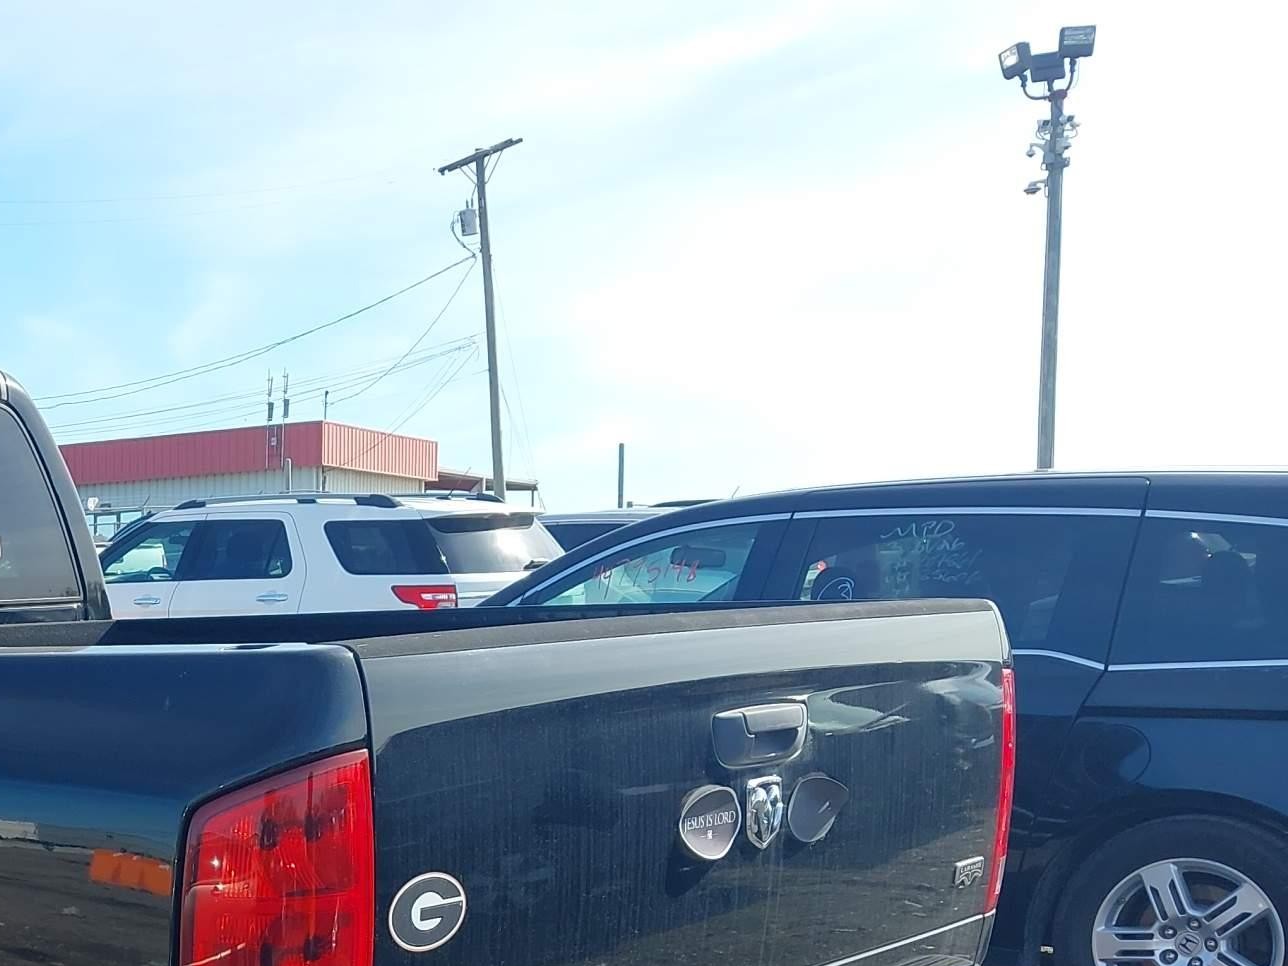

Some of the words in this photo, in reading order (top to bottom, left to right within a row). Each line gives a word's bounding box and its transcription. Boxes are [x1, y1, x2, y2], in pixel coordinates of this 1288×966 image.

[683, 815, 705, 833] JESUS
[706, 814, 713, 828] IS
[714, 810, 737, 826] LORD
